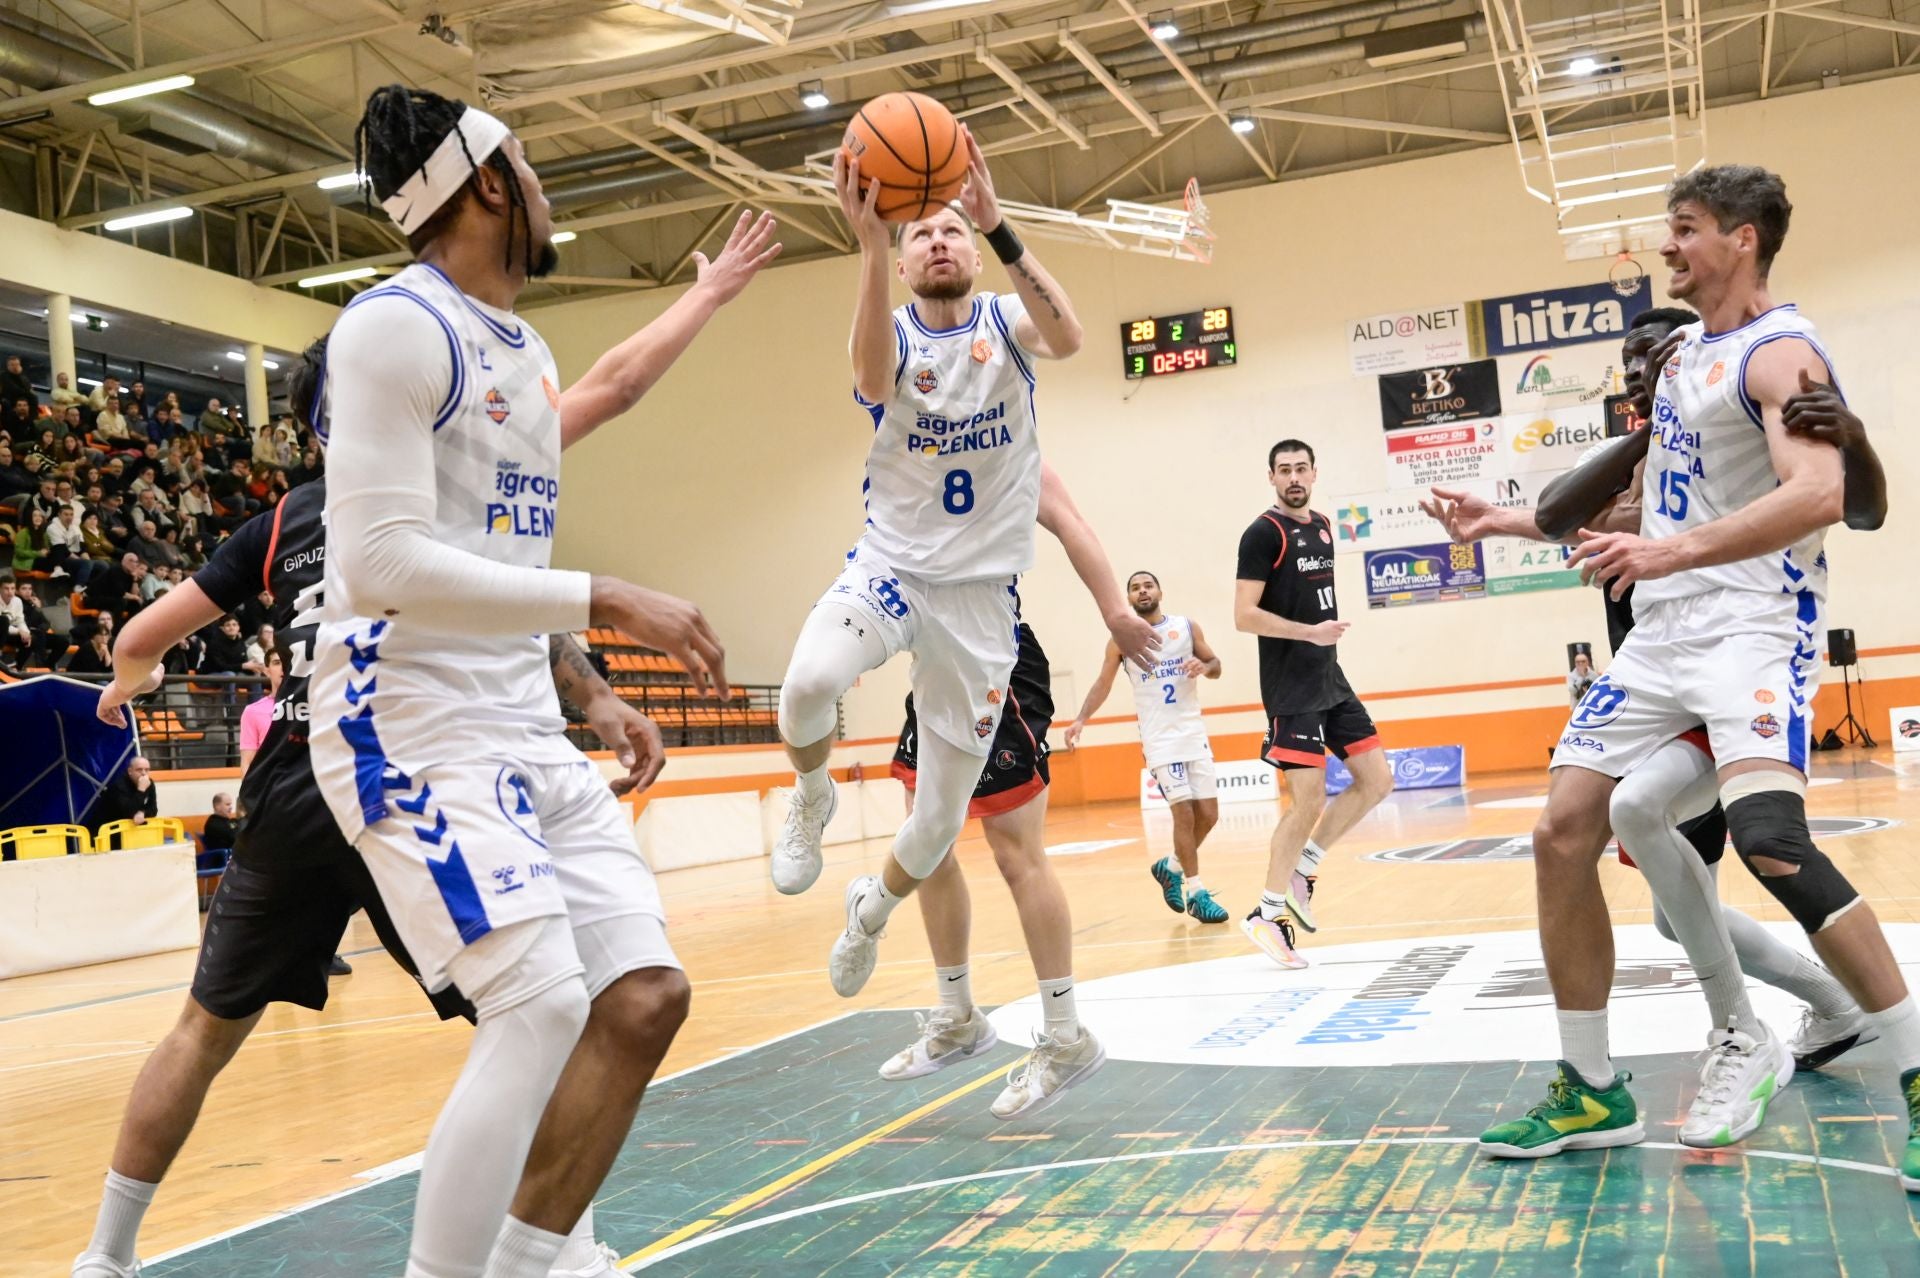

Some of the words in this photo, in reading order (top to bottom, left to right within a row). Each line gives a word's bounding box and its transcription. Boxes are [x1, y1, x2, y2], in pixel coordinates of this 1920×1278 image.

[1203, 308, 1227, 331] 28
[1353, 309, 1459, 342] ALD@NET
[1499, 299, 1624, 347] hitza
[1131, 320, 1155, 342] 28
[1171, 324, 1182, 341] 2
[1224, 343, 1235, 358] 4
[1134, 356, 1144, 373] 3
[1153, 348, 1207, 374] 02:54
[1411, 396, 1466, 415] BETIKO
[1415, 432, 1449, 444] RAPID
[1451, 430, 1469, 440] OIL
[1396, 451, 1440, 464] BIZKOR
[1445, 444, 1495, 458] AUTOAK
[943, 469, 974, 515] 8
[1656, 468, 1691, 521] 15
[1370, 562, 1408, 580] LAU
[1372, 573, 1440, 588] NEUMATIKOAK
[1163, 684, 1176, 704] 2
